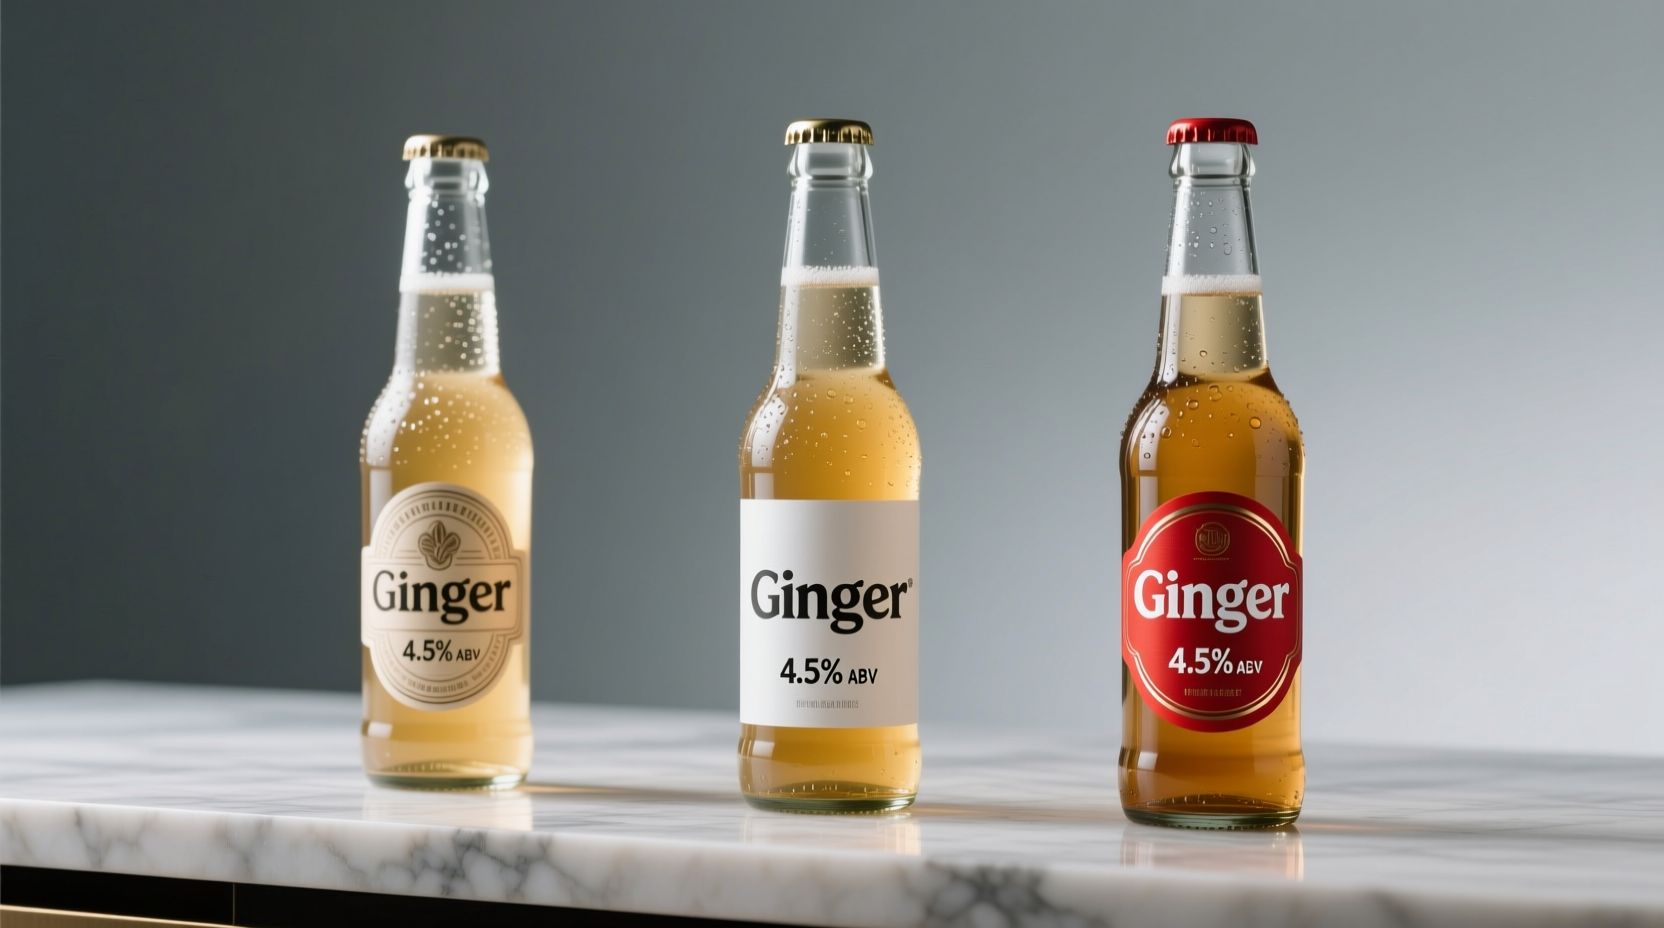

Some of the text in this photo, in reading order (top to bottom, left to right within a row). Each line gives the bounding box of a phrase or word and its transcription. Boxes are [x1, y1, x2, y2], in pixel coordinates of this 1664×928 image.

[373, 569, 511, 625] Ginger
[751, 569, 908, 635] Ginger
[1133, 569, 1290, 634] Ginger
[402, 639, 481, 662] 4.5% ABV
[780, 657, 878, 685] 4.5% ABV
[1168, 647, 1234, 675] 4.5%
